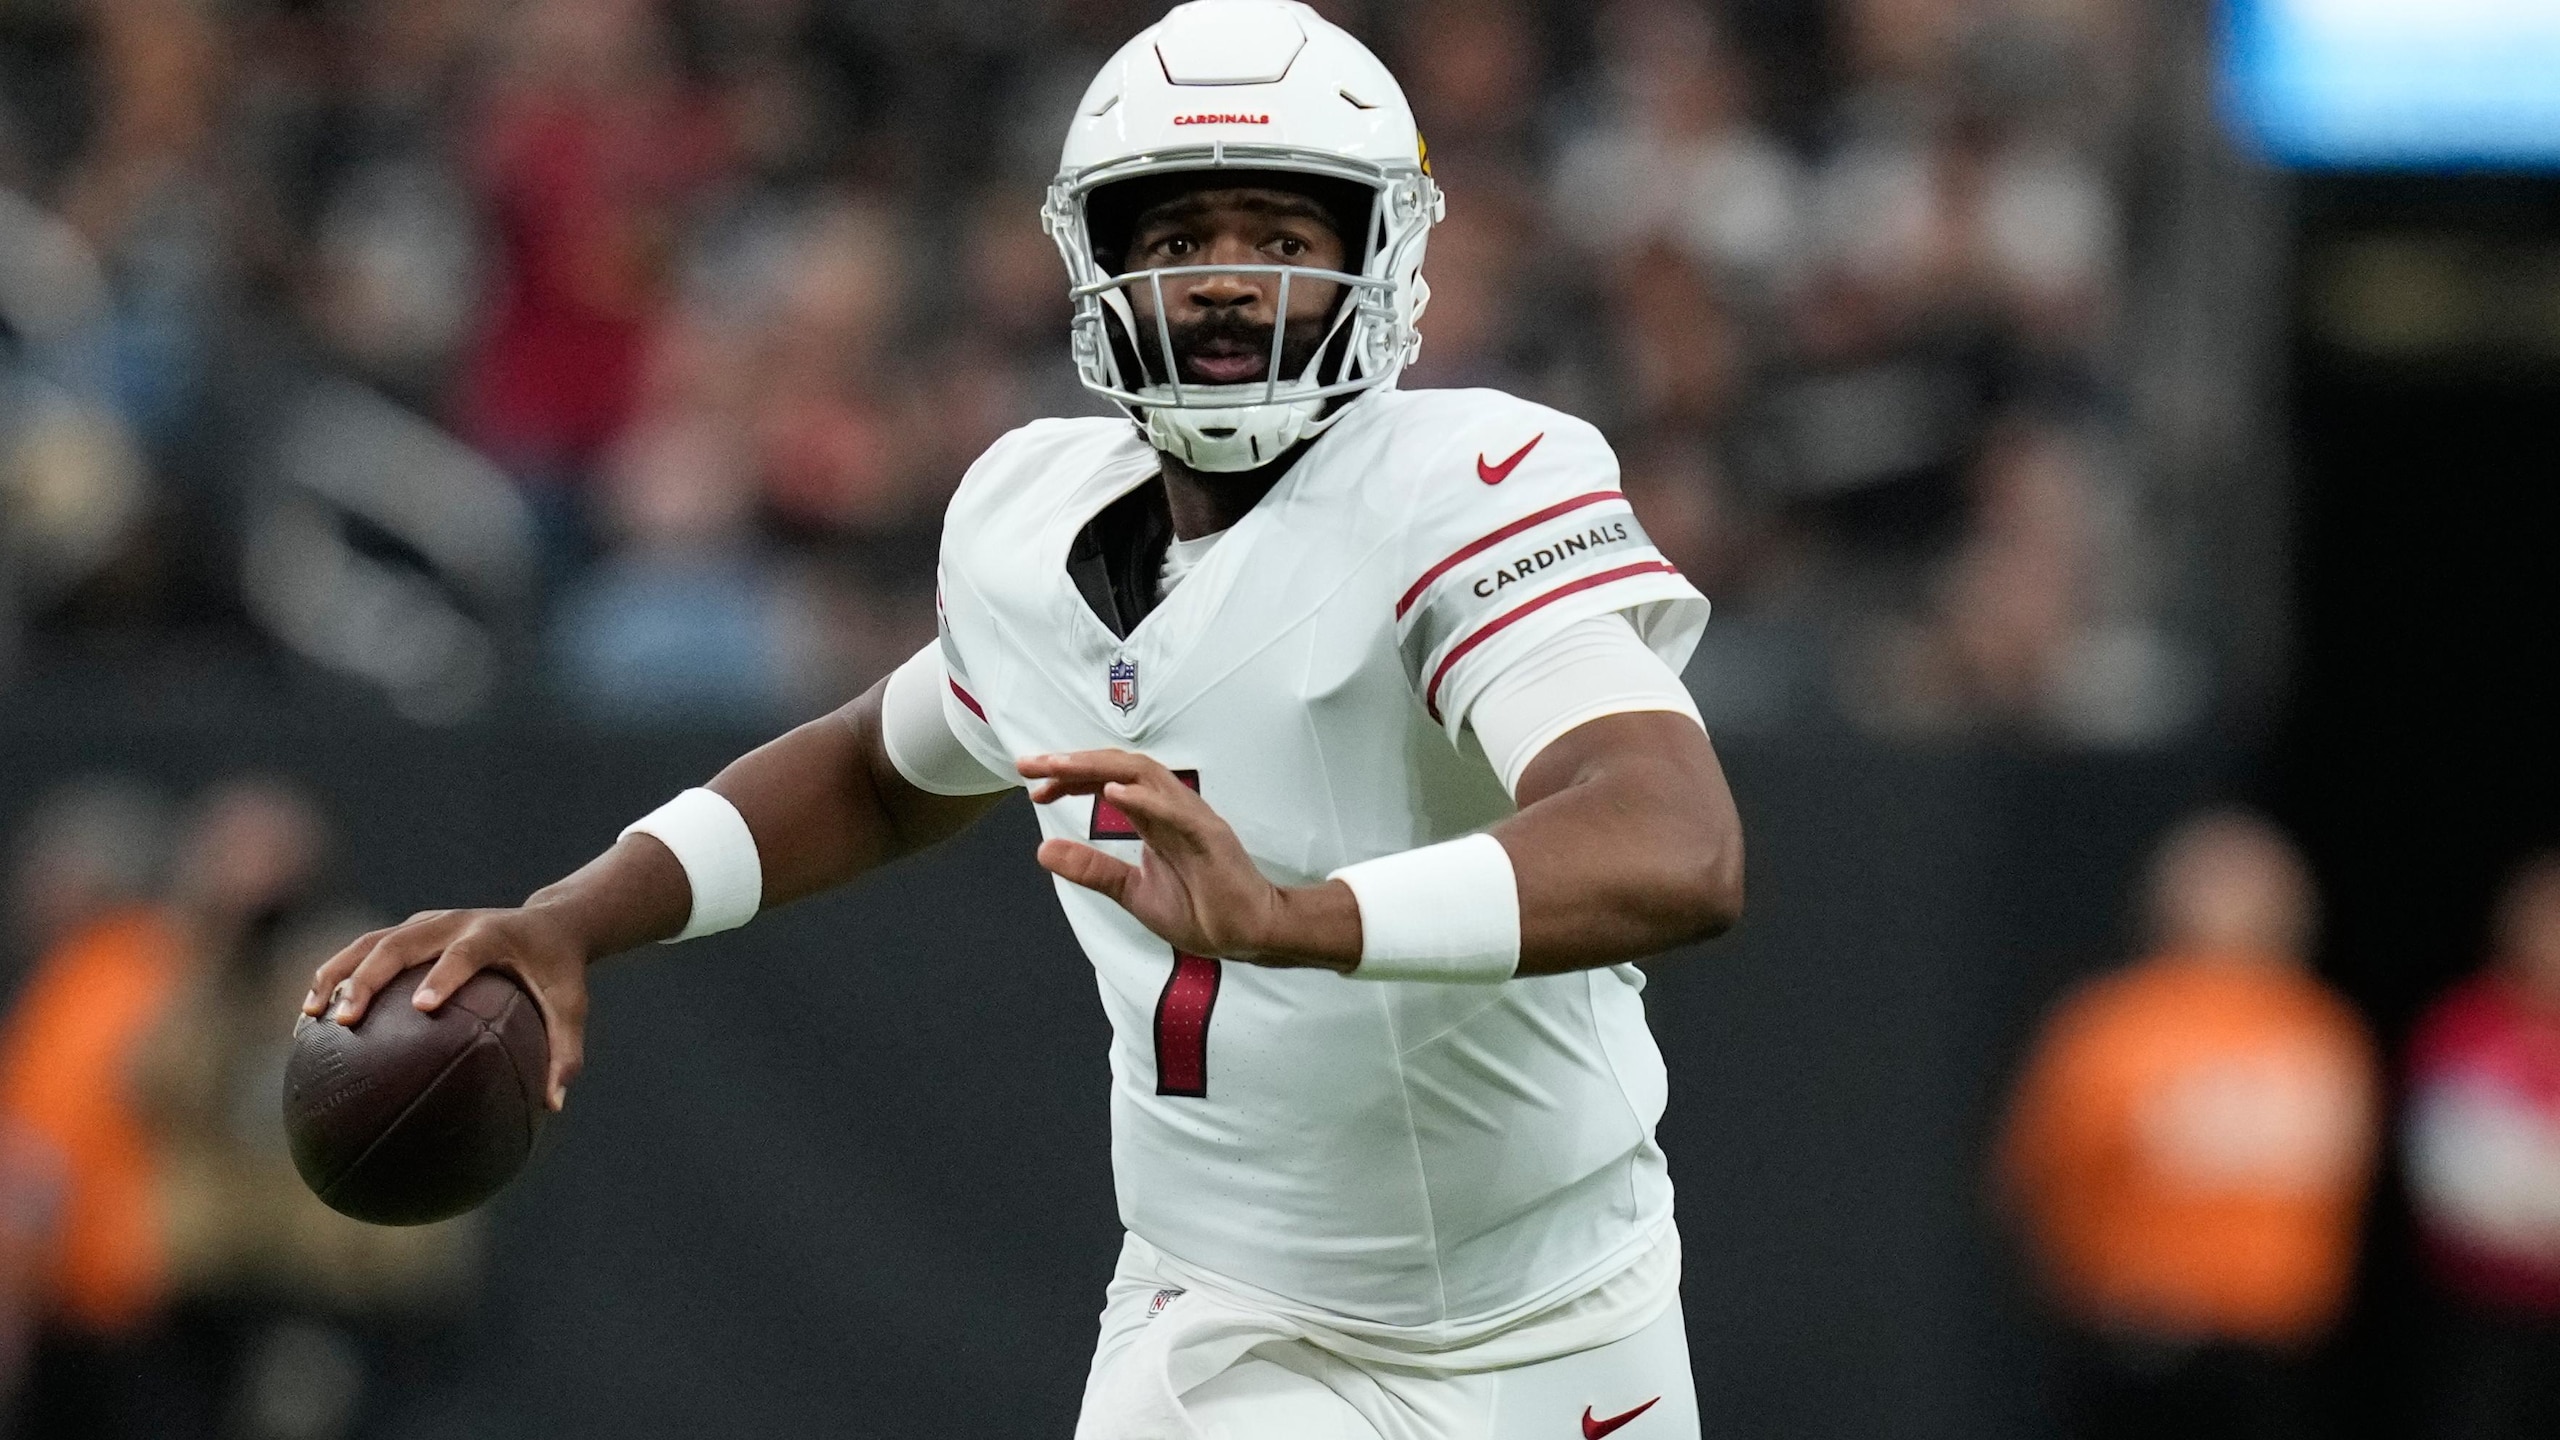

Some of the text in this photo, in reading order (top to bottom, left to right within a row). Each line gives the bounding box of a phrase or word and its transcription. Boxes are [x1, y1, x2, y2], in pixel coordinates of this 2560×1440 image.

[1173, 114, 1269, 126] CARDINALS
[1473, 522, 1628, 598] CARDINALS
[1113, 682, 1134, 704] NFL
